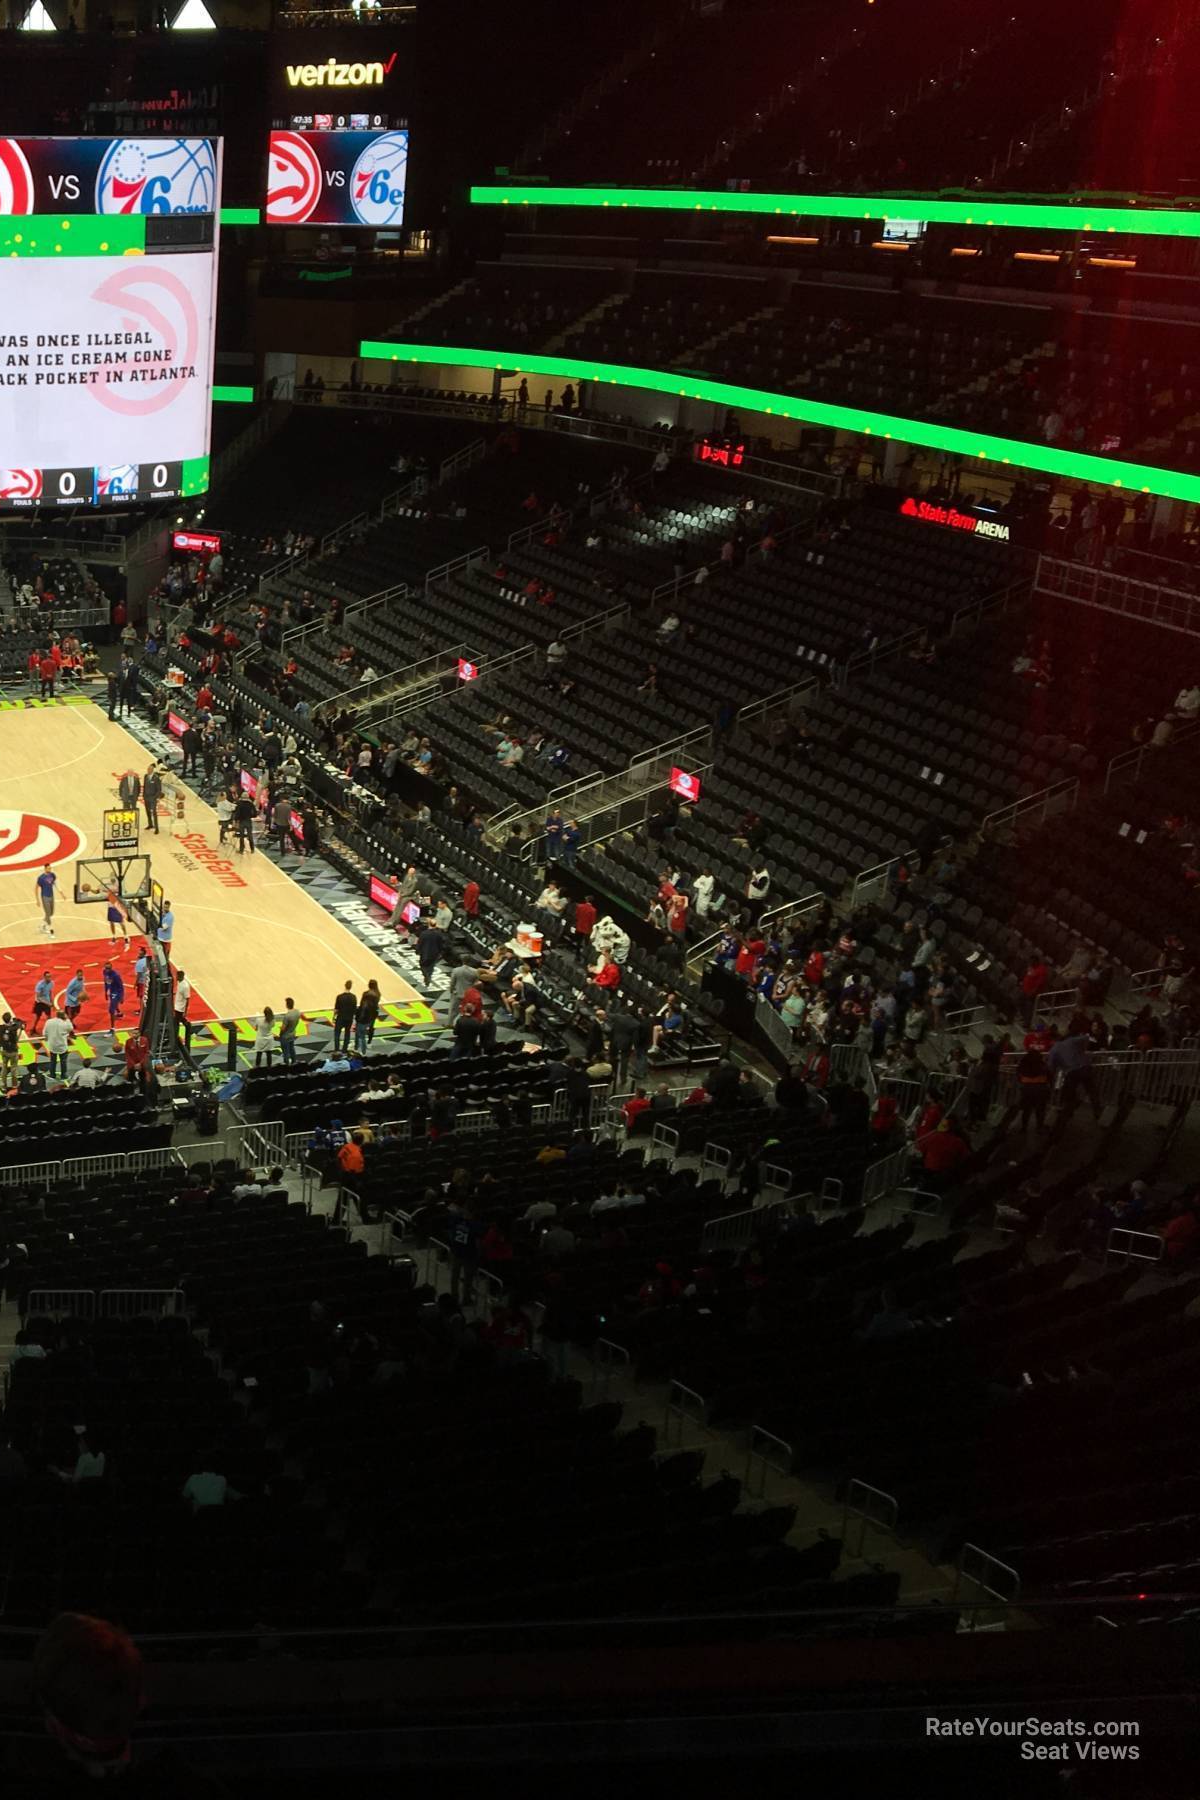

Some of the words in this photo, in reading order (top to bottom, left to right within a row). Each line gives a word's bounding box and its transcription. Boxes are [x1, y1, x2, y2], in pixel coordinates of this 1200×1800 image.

[286, 57, 384, 87] verizon
[337, 116, 346, 127] 0
[373, 115, 382, 126] 0
[47, 174, 81, 200] VS
[325, 170, 345, 187] VS
[36, 335, 80, 347] ONCE
[87, 332, 153, 346] ILLEGAL
[6, 354, 29, 366] AN
[37, 353, 64, 366] ICE
[71, 351, 127, 366] CREAM
[134, 349, 172, 363] CONE
[35, 371, 99, 385] POCKET
[106, 370, 123, 383] IN
[59, 472, 76, 496] 0
[153, 464, 168, 488] 0
[111, 494, 130, 502] FOULS
[918, 501, 947, 524] State
[946, 508, 977, 531] Farm
[975, 519, 1010, 541] ARENA
[169, 852, 200, 872] ARENA
[382, 946, 415, 970] Casino
